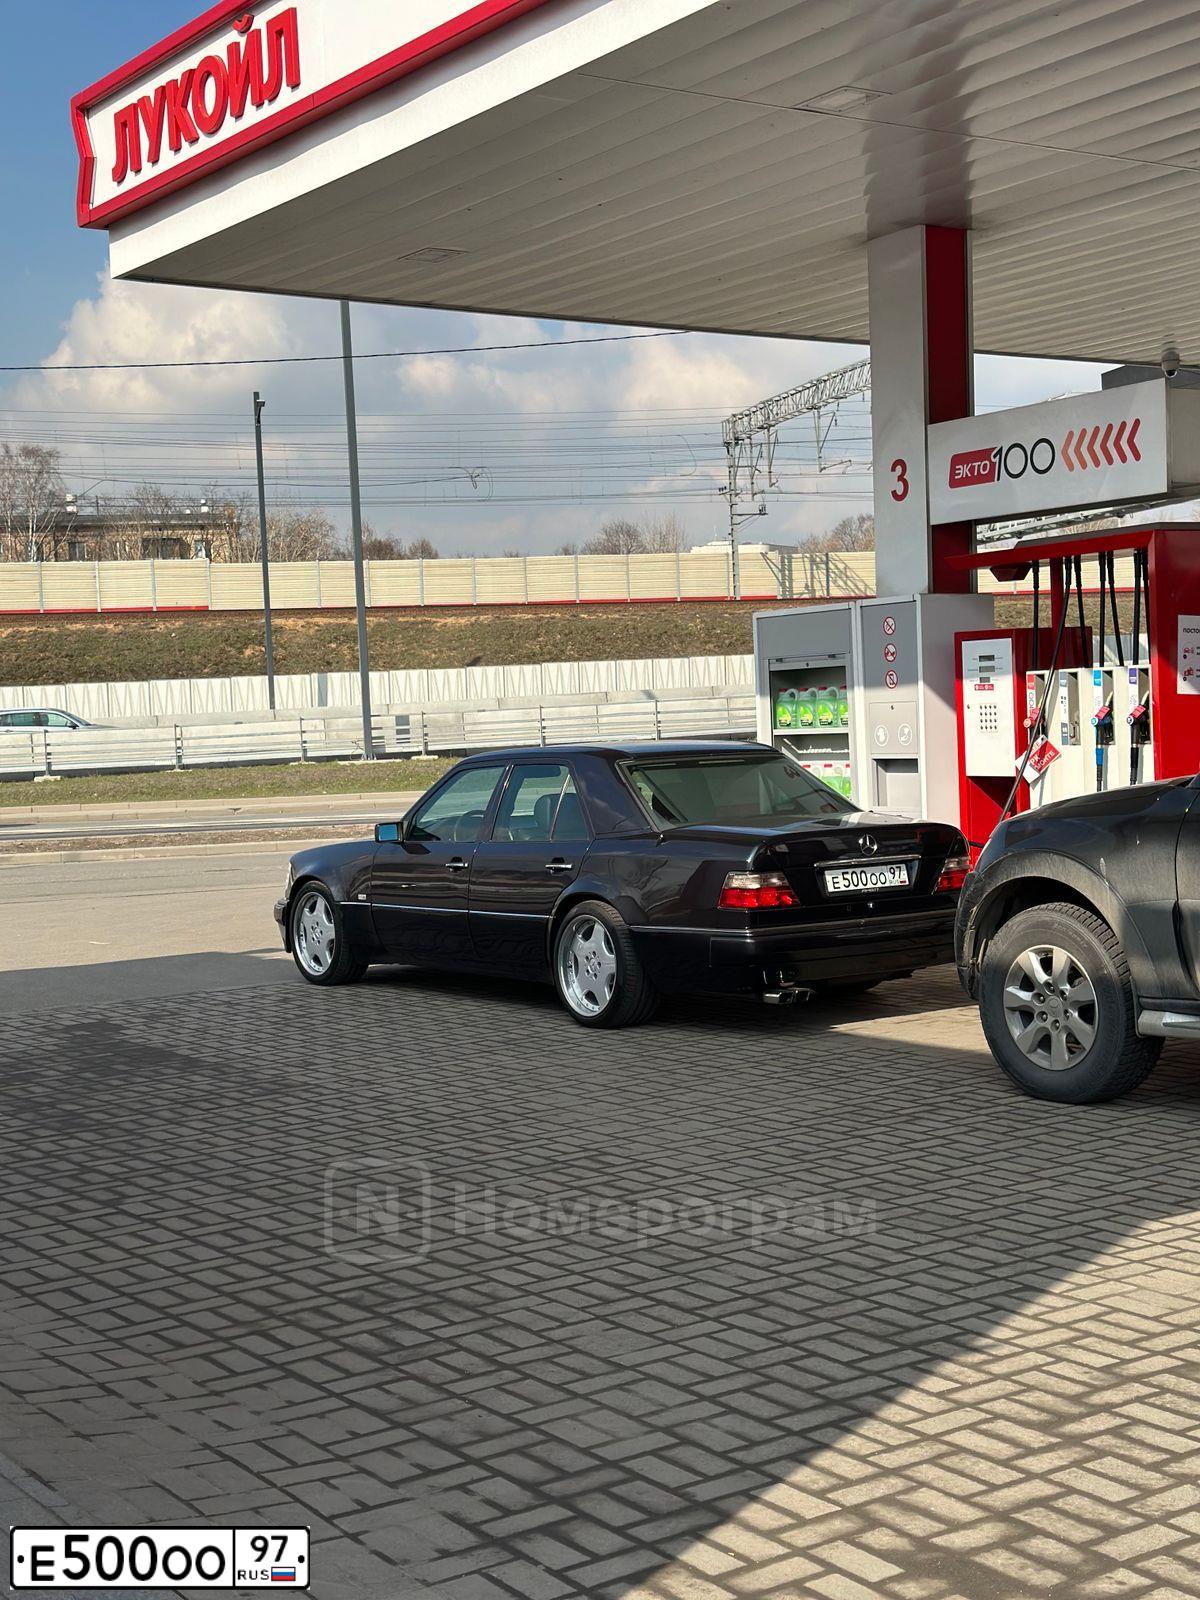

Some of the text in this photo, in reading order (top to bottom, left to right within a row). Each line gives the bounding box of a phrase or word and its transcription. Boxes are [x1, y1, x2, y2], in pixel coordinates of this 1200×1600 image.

[112, 8, 301, 182] ЛУКОЙЛ
[890, 459, 910, 502] 3
[954, 438, 1056, 482] ЭКТО 100
[889, 866, 902, 880] 97
